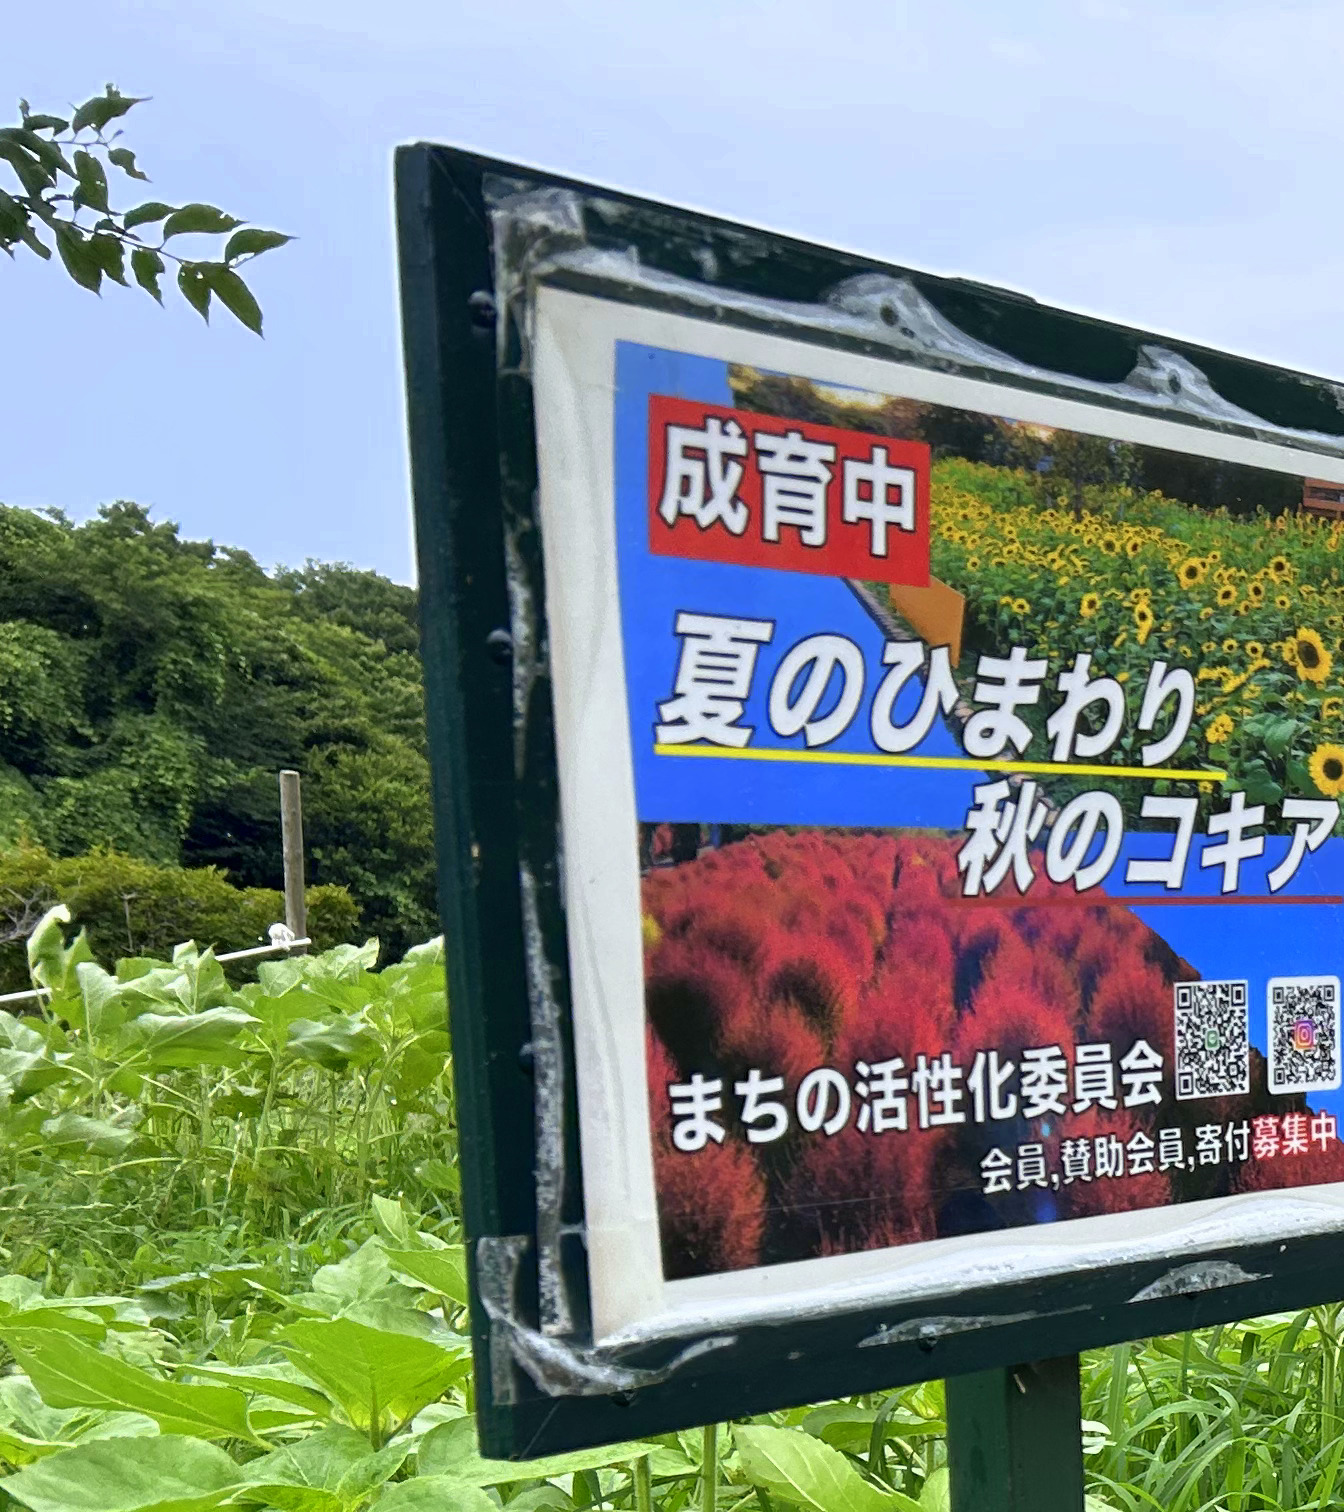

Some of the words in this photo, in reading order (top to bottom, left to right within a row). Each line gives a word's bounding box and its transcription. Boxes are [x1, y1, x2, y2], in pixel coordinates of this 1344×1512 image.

[658, 413, 917, 559] 成育中
[654, 609, 1197, 767] 夏のひまわり
[957, 779, 1342, 896] 秋のコキア
[667, 1038, 1165, 1152] まちの活性化委員会
